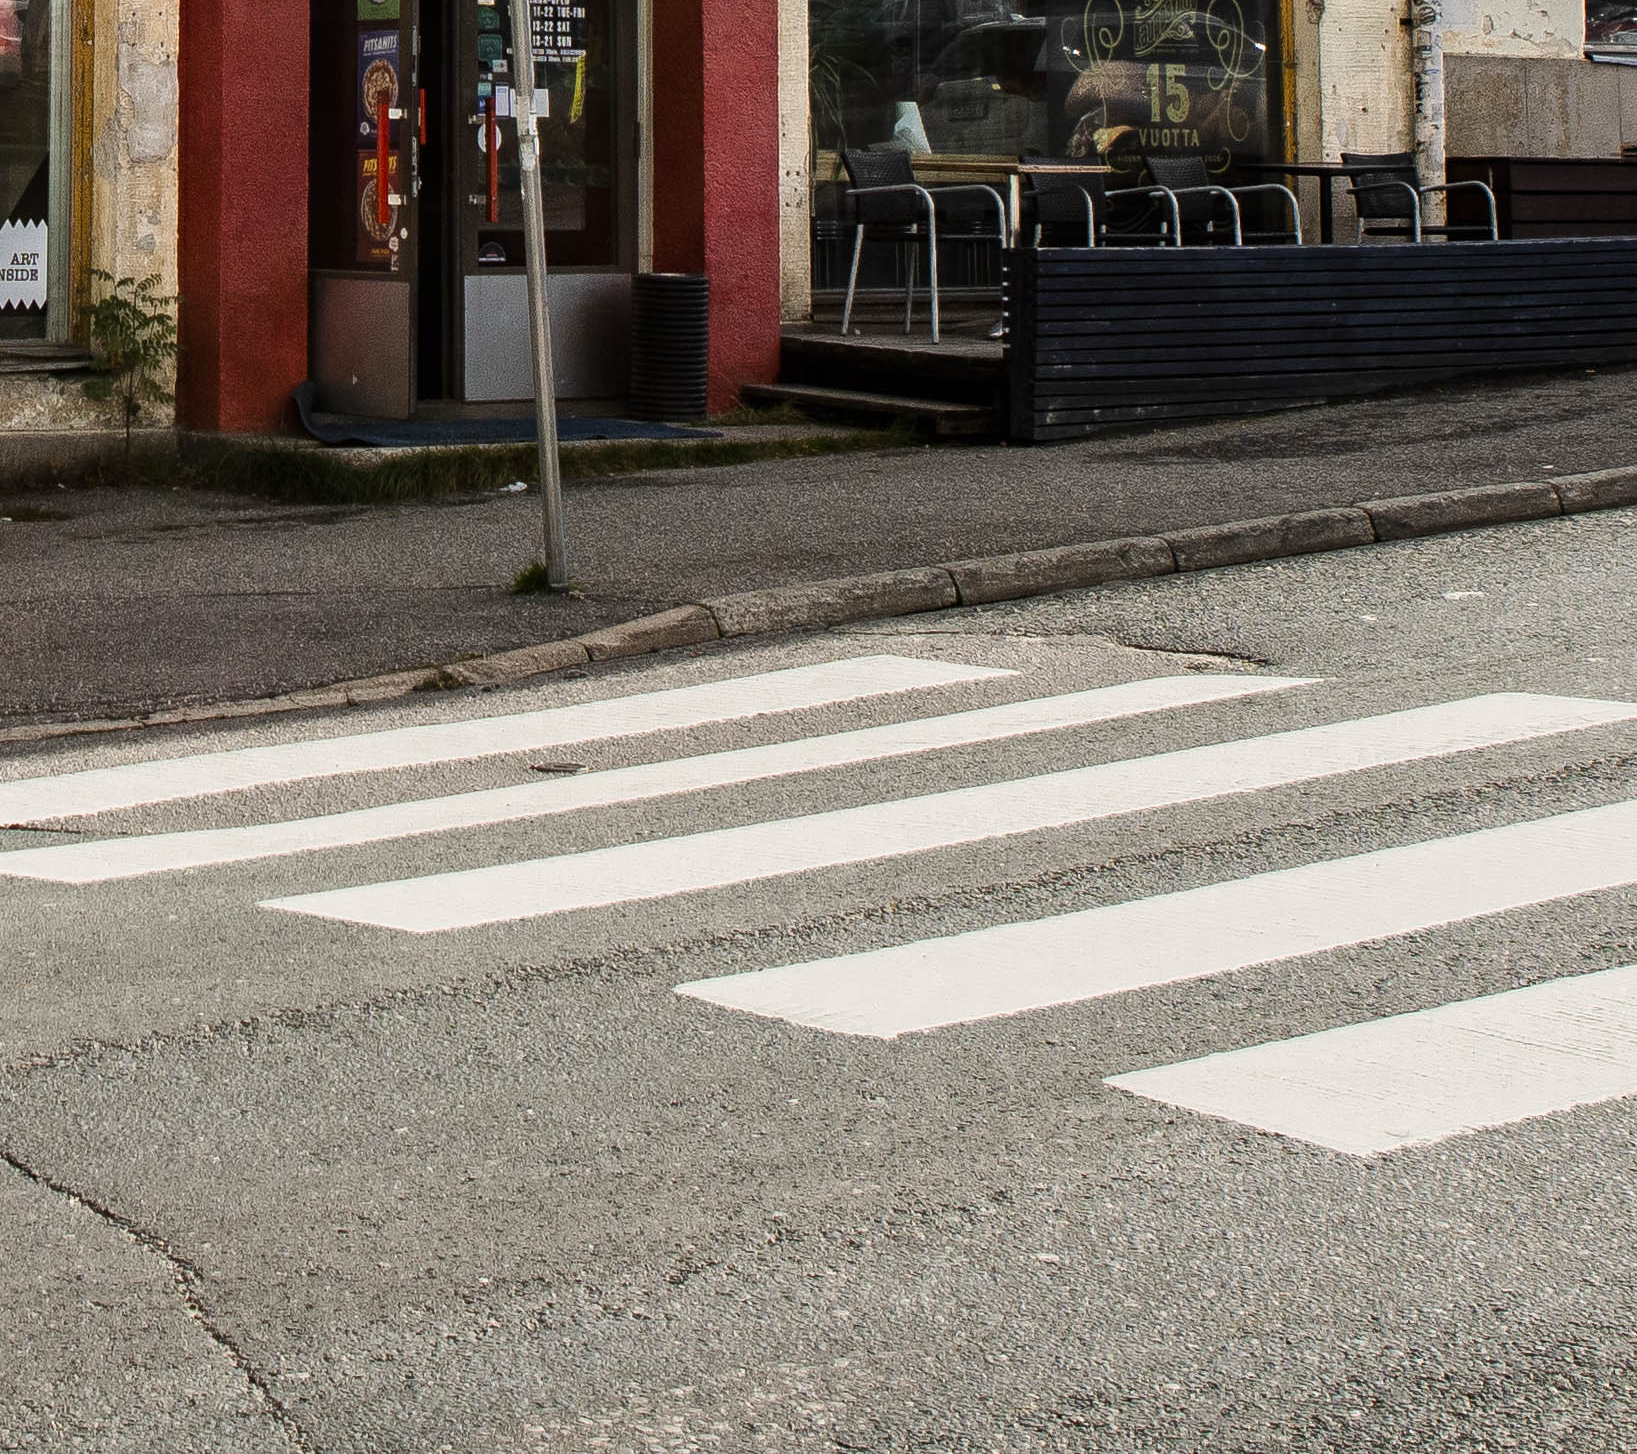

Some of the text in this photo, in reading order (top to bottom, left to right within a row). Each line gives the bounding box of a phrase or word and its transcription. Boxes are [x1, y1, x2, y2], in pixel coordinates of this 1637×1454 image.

[1146, 63, 1191, 123] 15
[1139, 128, 1201, 147] VUOTTA
[10, 252, 39, 266] ART
